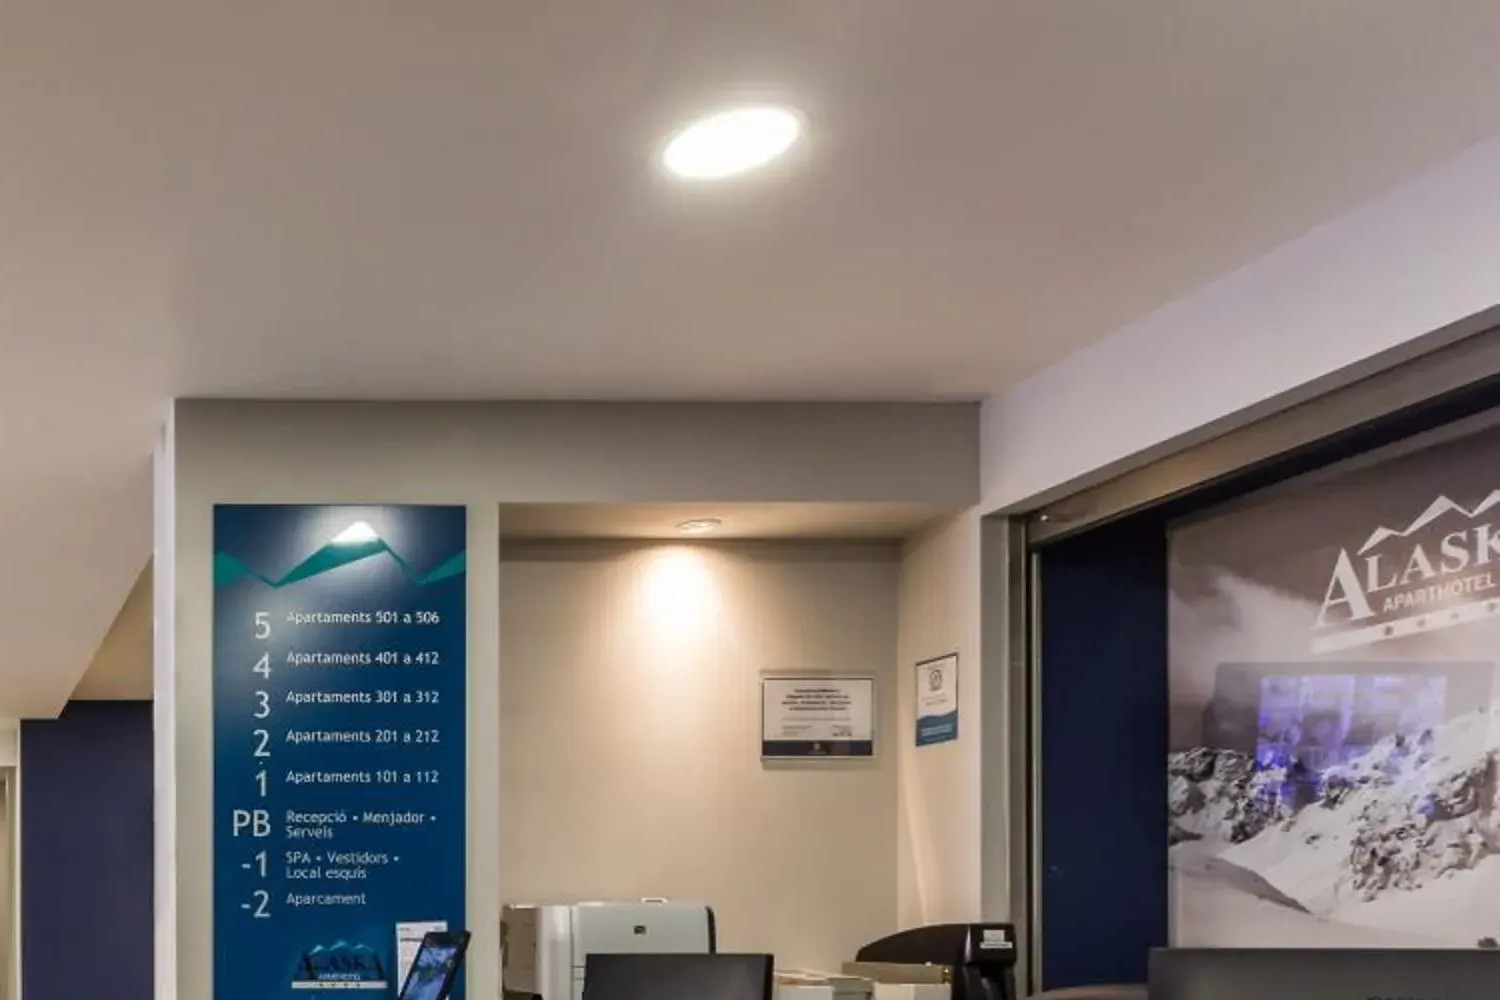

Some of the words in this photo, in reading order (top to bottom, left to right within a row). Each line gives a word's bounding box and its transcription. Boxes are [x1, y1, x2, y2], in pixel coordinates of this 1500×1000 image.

[1382, 571, 1498, 614] APARTHOTEL
[254, 611, 271, 639] 5
[285, 611, 371, 625] Apartaments
[375, 611, 398, 623] 501
[403, 614, 411, 623] a
[415, 611, 440, 623] 506
[252, 651, 272, 680] 4
[285, 651, 371, 666] Apartaments
[375, 651, 398, 664] 401
[403, 654, 411, 664] a
[415, 651, 440, 664] 412
[253, 690, 271, 719] 3
[285, 690, 371, 705] Apartaments
[375, 690, 398, 703] 301
[403, 693, 411, 703] a
[415, 690, 440, 703] 312
[252, 729, 271, 757] 2
[285, 729, 371, 744] Apartaments
[375, 729, 398, 742] 201
[403, 732, 411, 742] a
[415, 729, 440, 742] 212
[255, 770, 268, 797] 1
[285, 770, 371, 785] Apartaments
[375, 770, 398, 783] 101
[403, 773, 411, 783] a
[415, 770, 440, 783] 112
[232, 809, 271, 837] PB
[362, 811, 425, 827] Menjador
[285, 826, 334, 839] Serveis
[241, 850, 268, 878] -1
[285, 851, 311, 864] SPA
[327, 851, 388, 864] Vestidors
[285, 867, 321, 879] Local
[240, 889, 271, 918] -2
[285, 893, 367, 907] Aparcament
